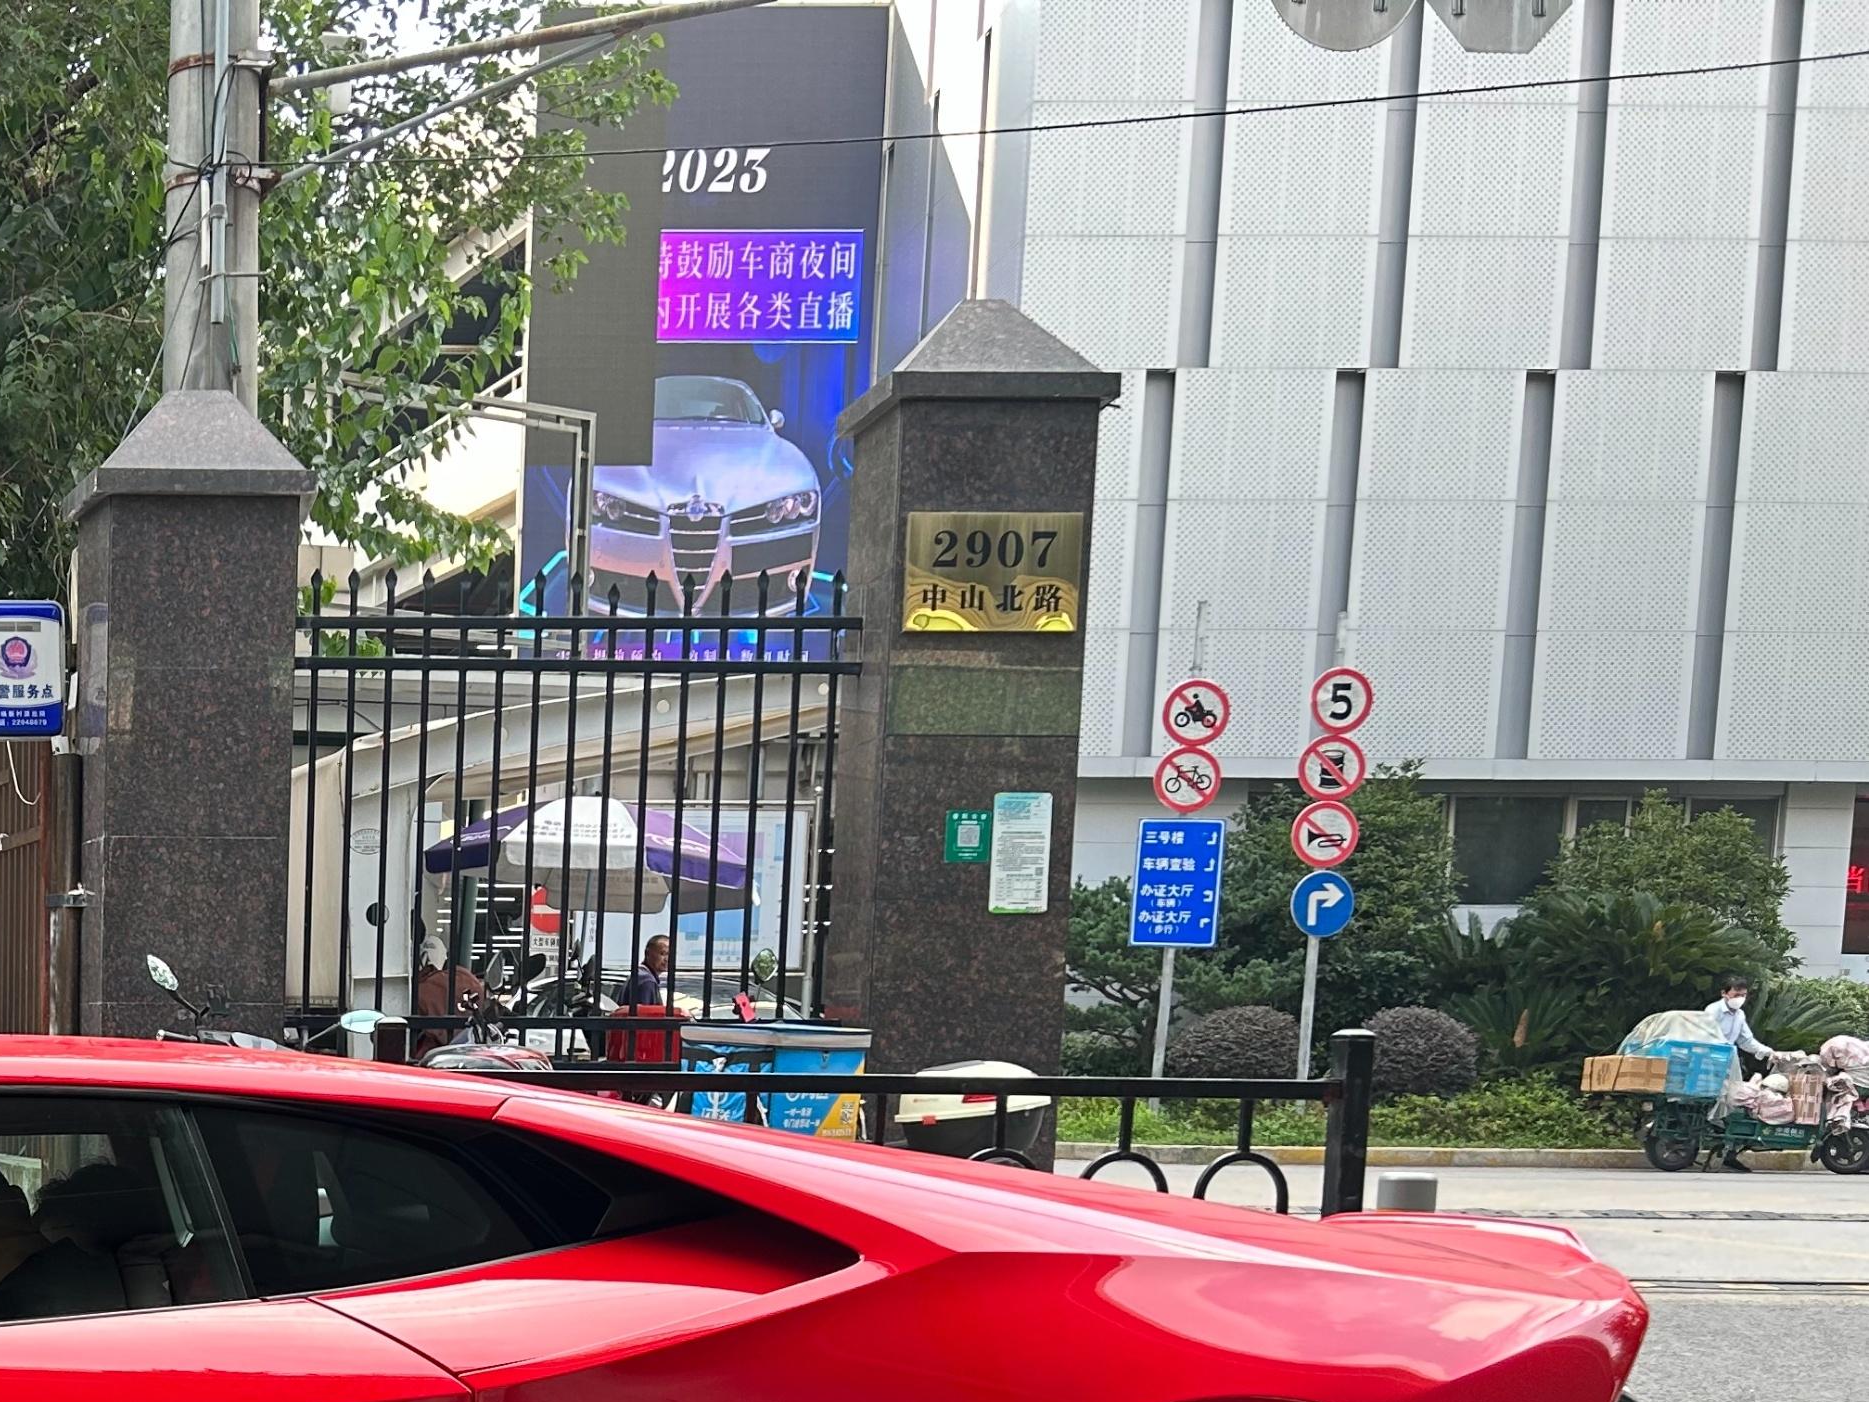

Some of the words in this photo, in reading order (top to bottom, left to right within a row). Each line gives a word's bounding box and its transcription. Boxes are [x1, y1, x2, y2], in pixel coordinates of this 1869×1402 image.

[932, 530, 1058, 569] 2907
[922, 584, 1062, 612] 中山北路
[1329, 682, 1353, 720] 5
[1143, 831, 1185, 845] 三号楼
[1142, 857, 1196, 872] 车辆查验
[1140, 883, 1194, 898] 办证大厅
[1138, 910, 1192, 924] 办证大厅
